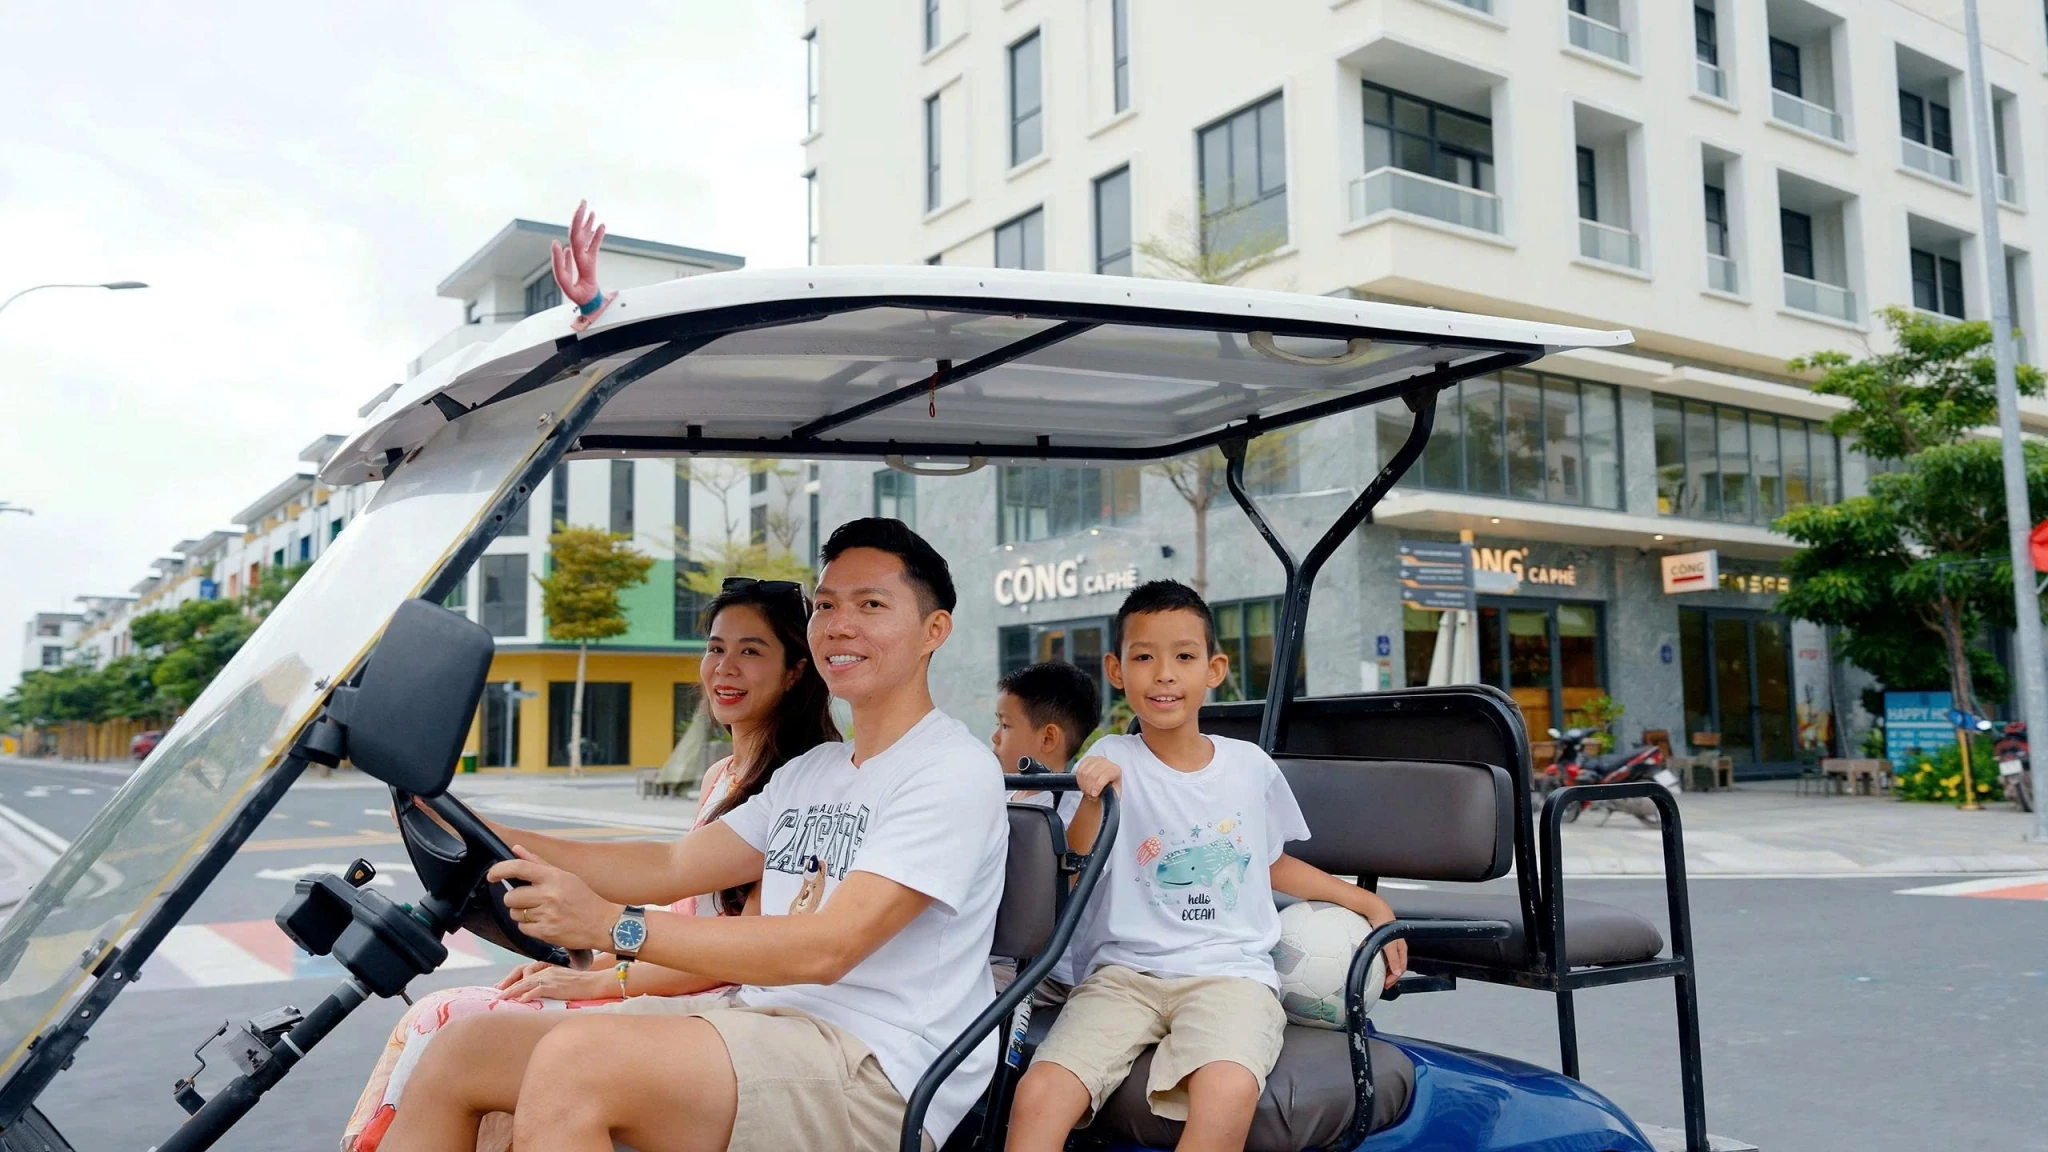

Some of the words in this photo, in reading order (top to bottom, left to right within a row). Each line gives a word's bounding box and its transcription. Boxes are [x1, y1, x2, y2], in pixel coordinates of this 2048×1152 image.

[1887, 707, 1929, 721] HAPPY
[1188, 893, 1211, 905] hello
[1181, 908, 1216, 921] OCEAN
